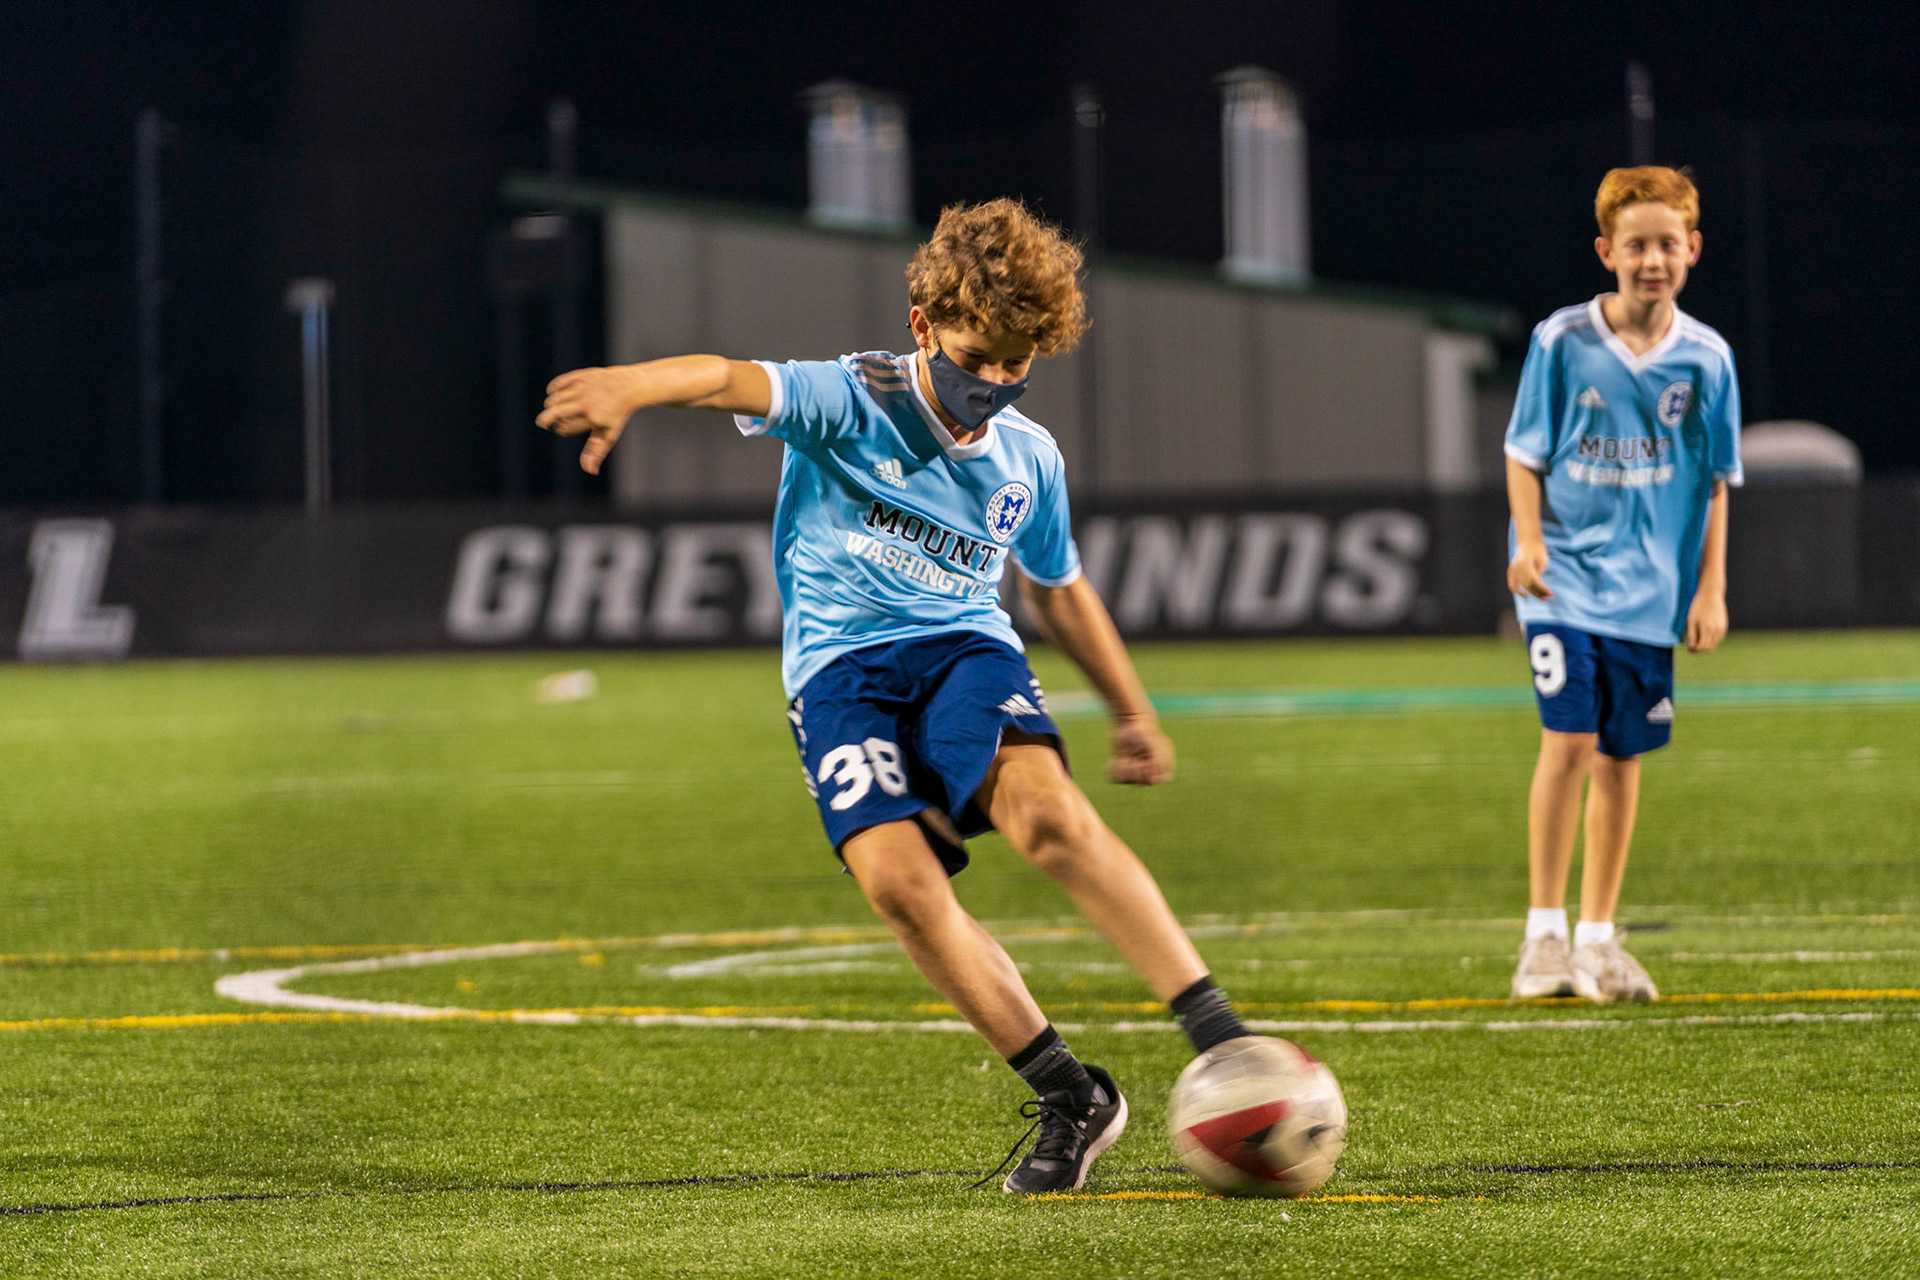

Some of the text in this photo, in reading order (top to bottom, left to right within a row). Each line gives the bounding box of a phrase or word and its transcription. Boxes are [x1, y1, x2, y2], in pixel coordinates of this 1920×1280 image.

[869, 467, 907, 490] adidas
[1565, 460, 1674, 488] WASHINTON
[1578, 434, 1673, 461] MOUNT
[845, 531, 992, 600] WASHINGTO
[864, 500, 999, 573] MOUNT
[21, 519, 134, 658] L
[446, 510, 1430, 642] GREYNDS
[1530, 632, 1567, 699] 9
[816, 736, 908, 811] 38
